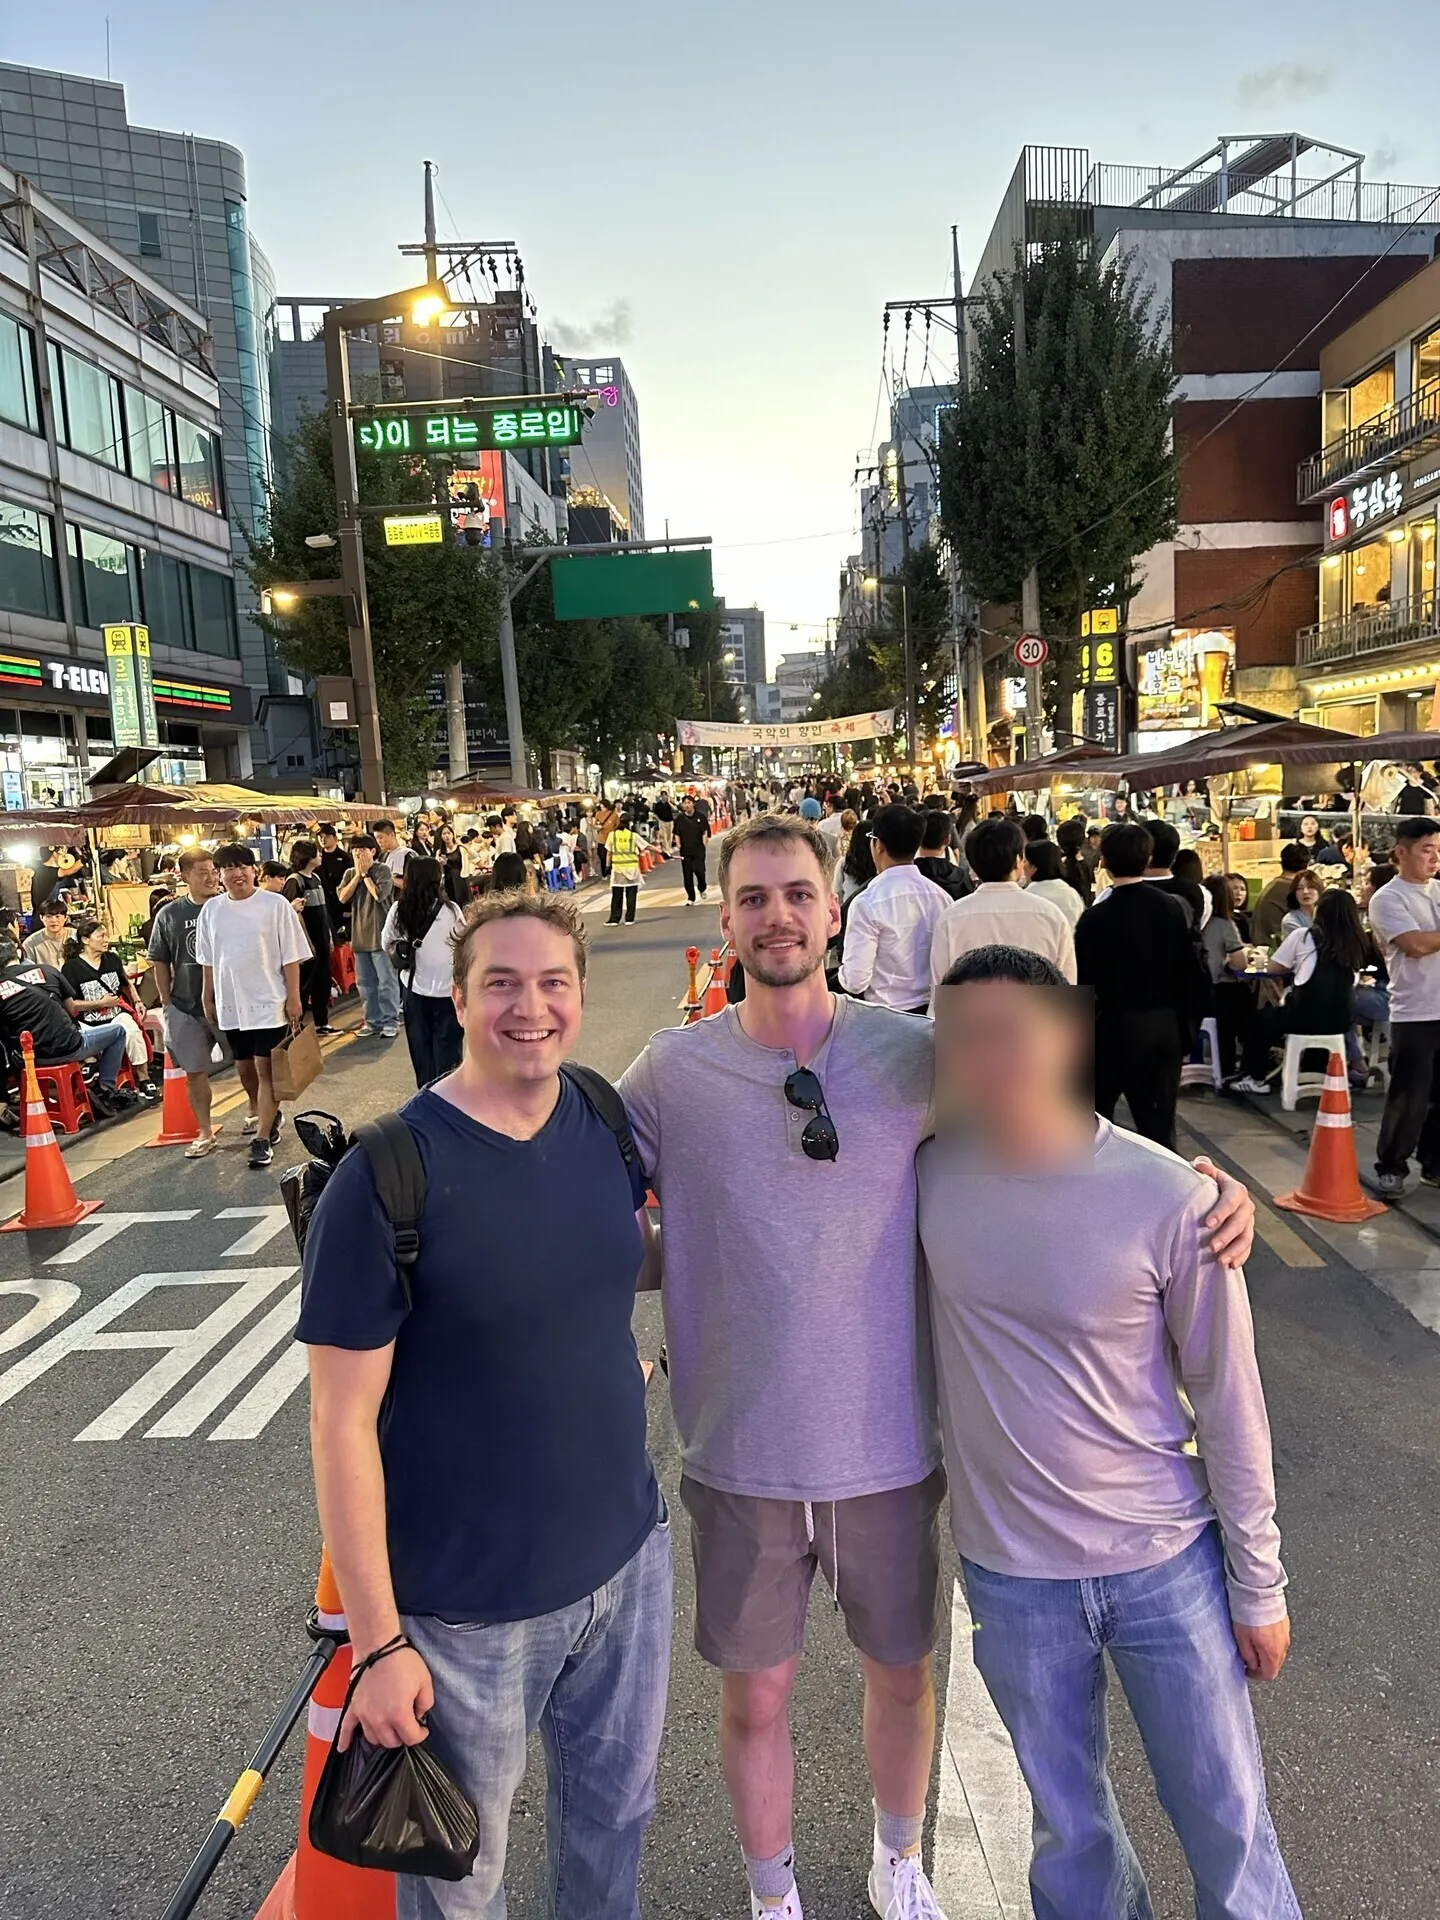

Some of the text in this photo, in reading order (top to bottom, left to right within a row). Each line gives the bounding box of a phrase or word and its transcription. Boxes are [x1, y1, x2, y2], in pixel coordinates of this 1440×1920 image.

[426, 416, 478, 444] 되는
[492, 409, 579, 441] 종로입
[1022, 642, 1040, 659] 30
[1097, 643, 1113, 667] 6
[1148, 650, 1187, 671] 반반
[116, 659, 126, 673] 3
[1150, 674, 1181, 696] 호프
[113, 685, 128, 728] 종로3가
[1095, 693, 1107, 742] 종로3가
[753, 727, 790, 738] 국악의
